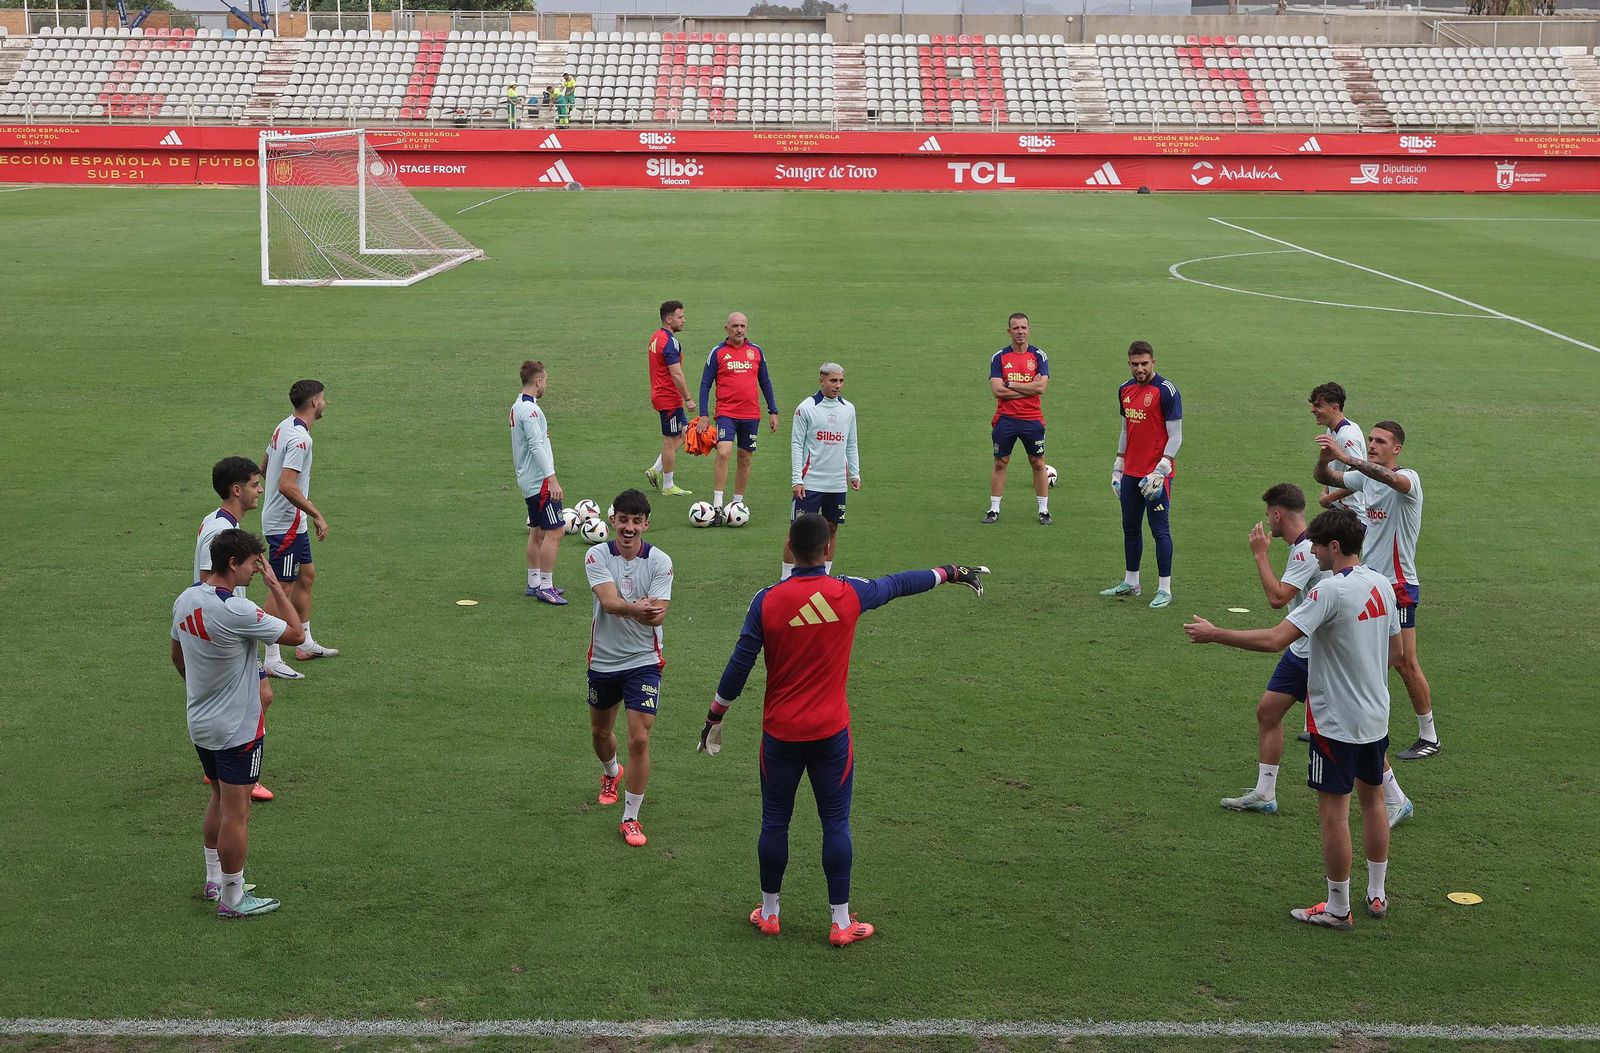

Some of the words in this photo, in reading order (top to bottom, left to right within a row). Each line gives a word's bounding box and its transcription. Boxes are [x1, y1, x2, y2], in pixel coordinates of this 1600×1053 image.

[639, 132, 676, 144] Silbö:
[1018, 135, 1056, 147] Silbö:
[1399, 136, 1436, 148] Silbö:
[70, 154, 162, 167] ESPAÑOLA
[169, 157, 191, 167] DE
[199, 155, 262, 167] FÚTBO
[400, 165, 431, 174] STAGE
[433, 165, 466, 174] FRONT
[646, 158, 704, 177] Silbö:
[775, 164, 827, 182] Sangre
[829, 165, 845, 179] de
[847, 165, 878, 179] Toro
[947, 162, 1016, 184] TCL
[1218, 164, 1284, 181] Andalucía
[1382, 164, 1427, 174] Diputación
[87, 170, 144, 179] SUB-21
[1382, 176, 1393, 184] de
[1396, 175, 1418, 184] Cádiz
[660, 177, 690, 185] Telecom
[727, 361, 752, 370] Silbö:
[816, 431, 845, 441] Silbö:
